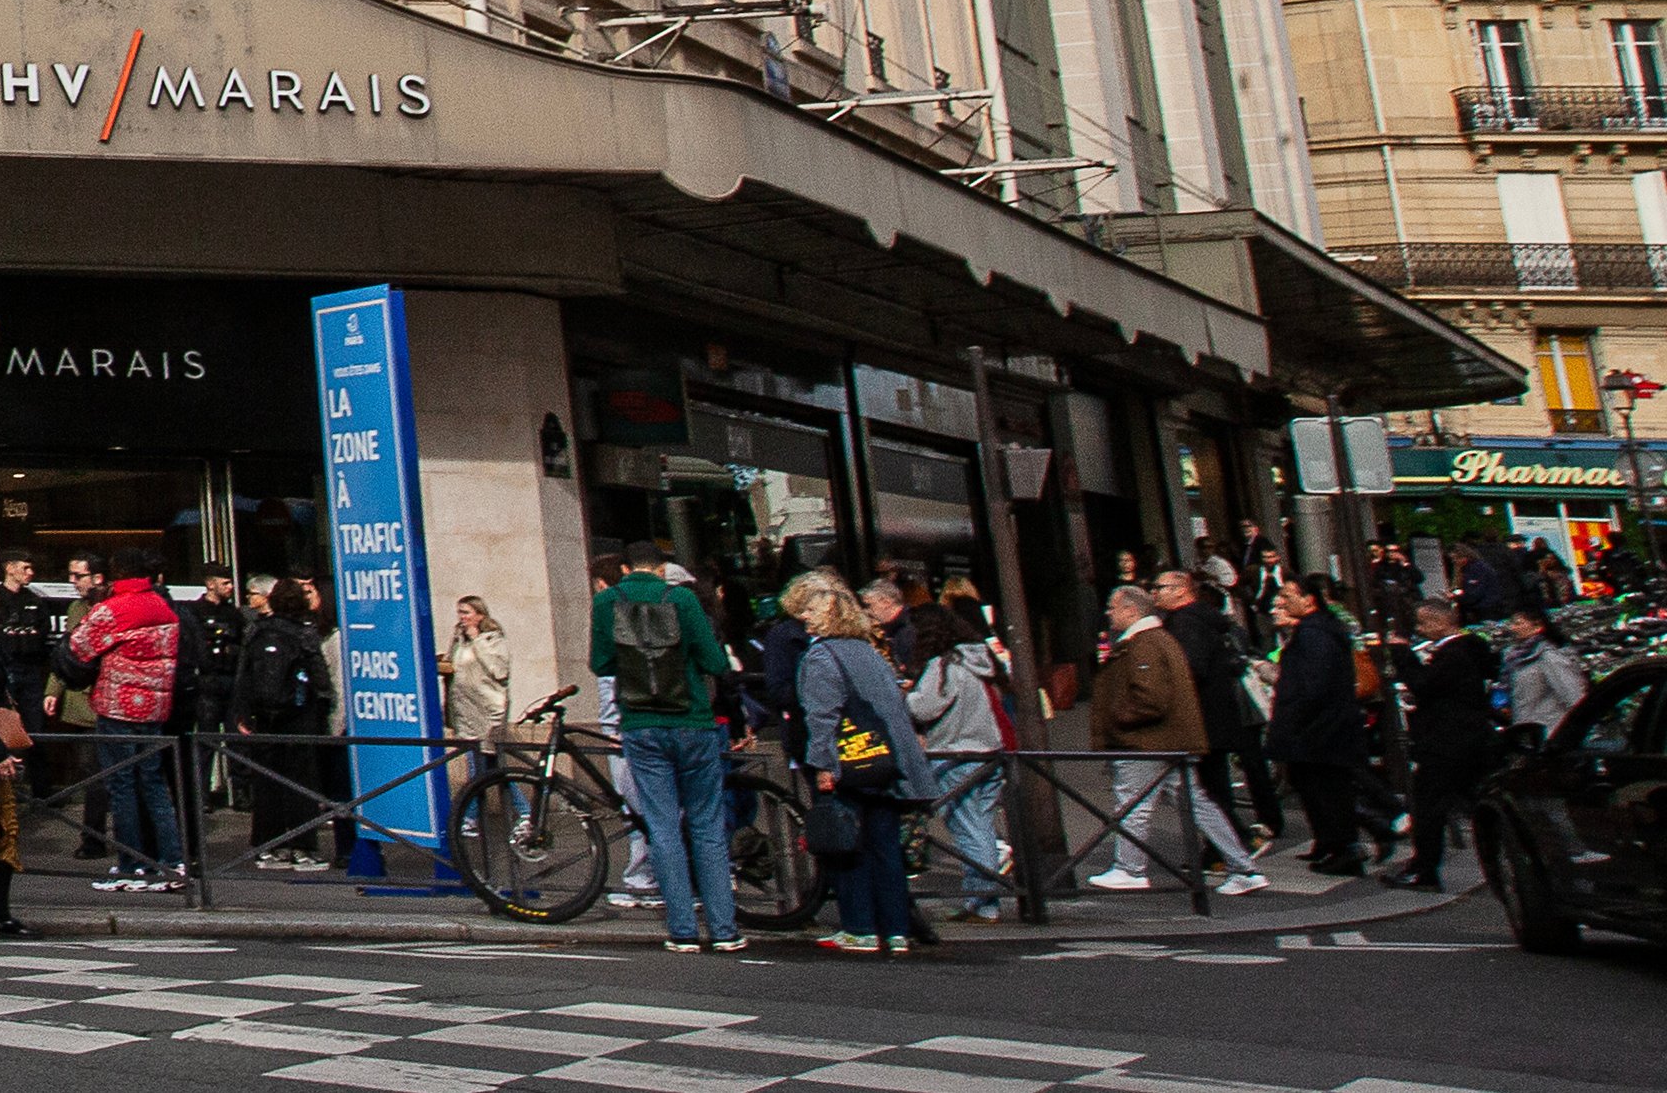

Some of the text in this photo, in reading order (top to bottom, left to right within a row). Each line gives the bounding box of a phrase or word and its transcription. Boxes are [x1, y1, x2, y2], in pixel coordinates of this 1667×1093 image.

[149, 65, 432, 116] MARAIS
[7, 348, 205, 379] MARAIS
[328, 387, 352, 418] LA
[331, 429, 380, 464] ZONE
[337, 470, 351, 509] À
[339, 521, 404, 555] TRAFIC
[344, 561, 404, 601] LIMITÉ
[350, 650, 400, 680] PARIS
[353, 691, 419, 723] CENTRE
